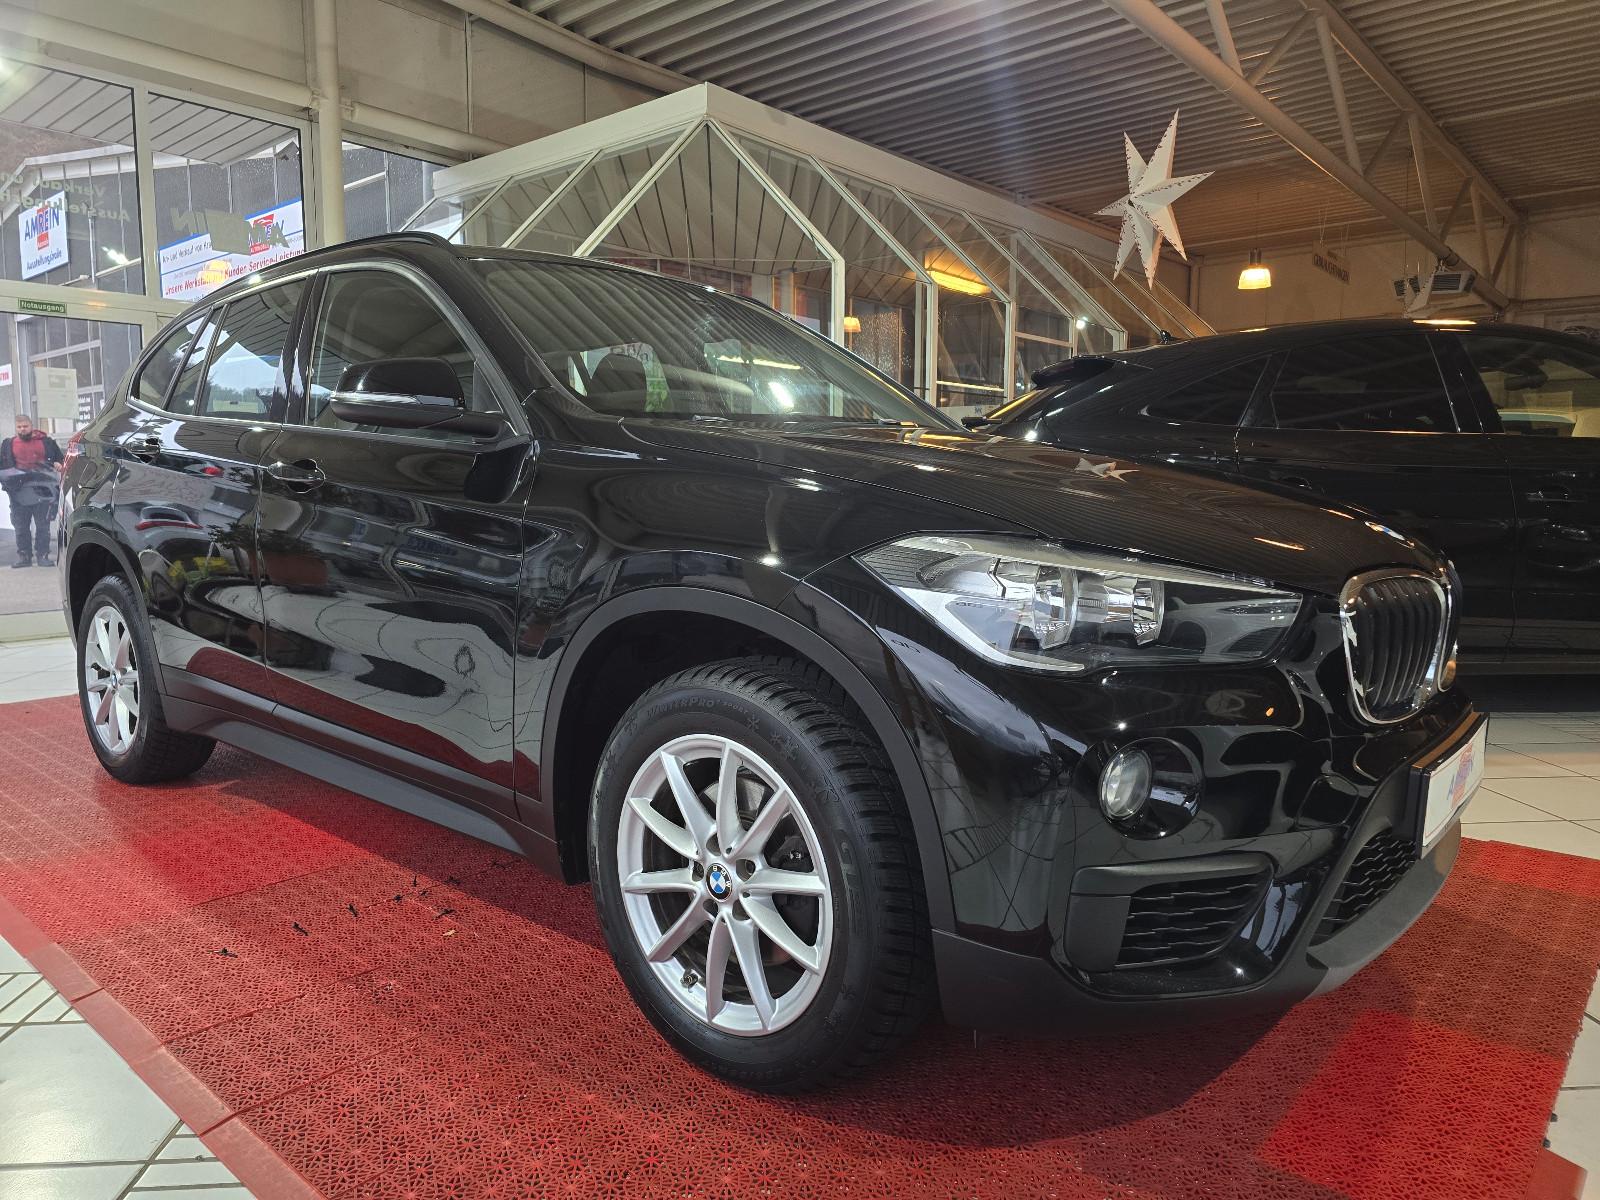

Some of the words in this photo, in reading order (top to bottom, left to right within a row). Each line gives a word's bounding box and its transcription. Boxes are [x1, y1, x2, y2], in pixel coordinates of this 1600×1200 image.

[24, 206, 60, 241] AMREIN
[21, 301, 65, 312] Notausgang
[712, 865, 732, 888] BMW
